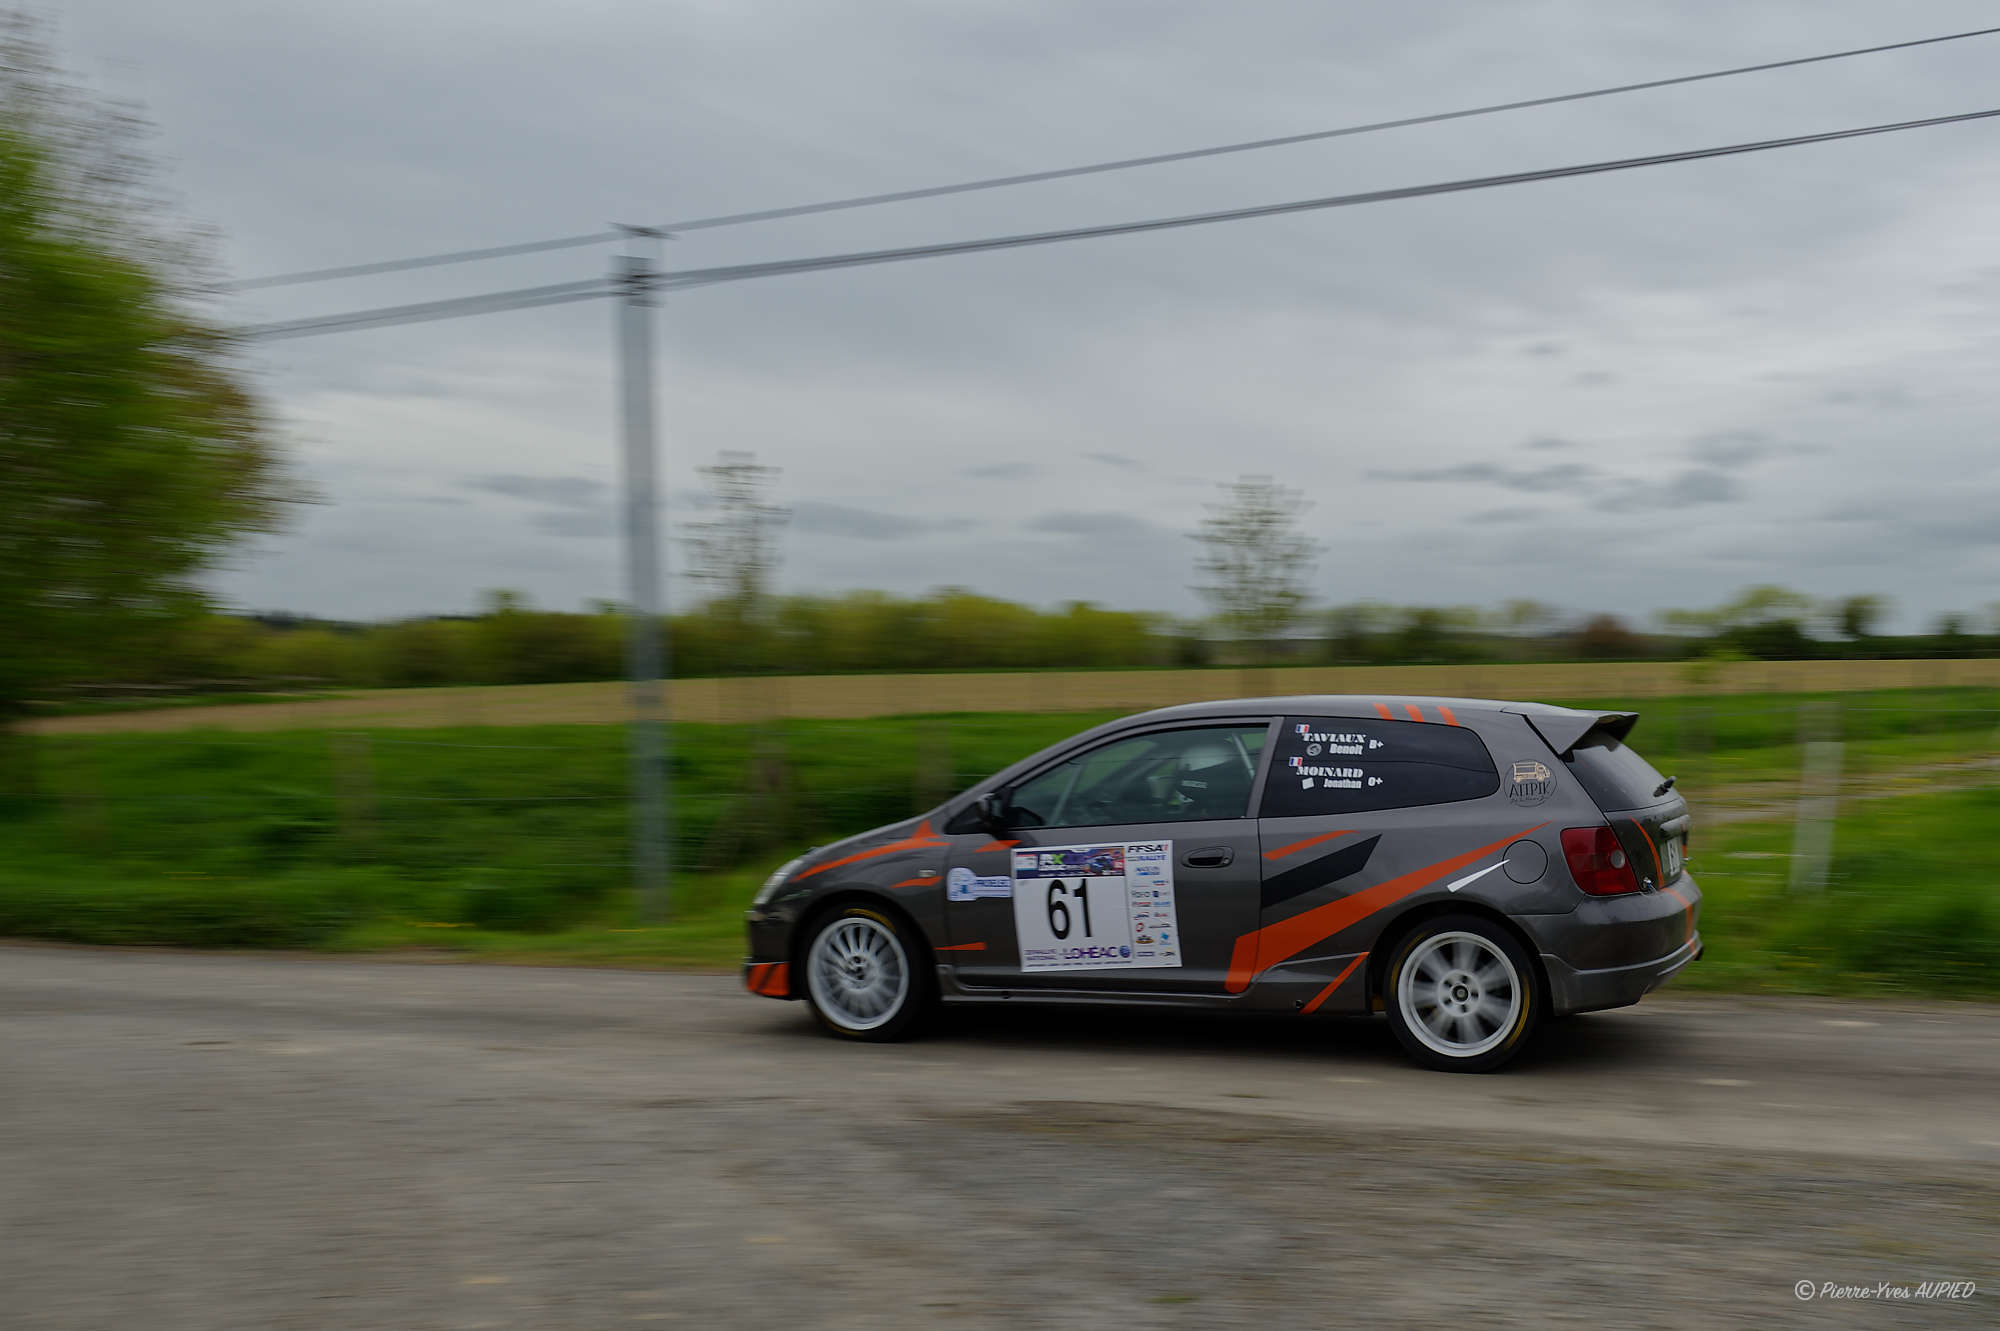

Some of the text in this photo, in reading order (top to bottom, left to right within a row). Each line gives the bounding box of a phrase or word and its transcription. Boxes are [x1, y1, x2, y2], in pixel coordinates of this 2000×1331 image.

[1302, 733, 1366, 743] TAVIAUX
[1296, 766, 1364, 778] MOINARD
[1323, 778, 1362, 789] Jonathan
[1128, 844, 1163, 853] FFSA
[1048, 878, 1092, 940] 61
